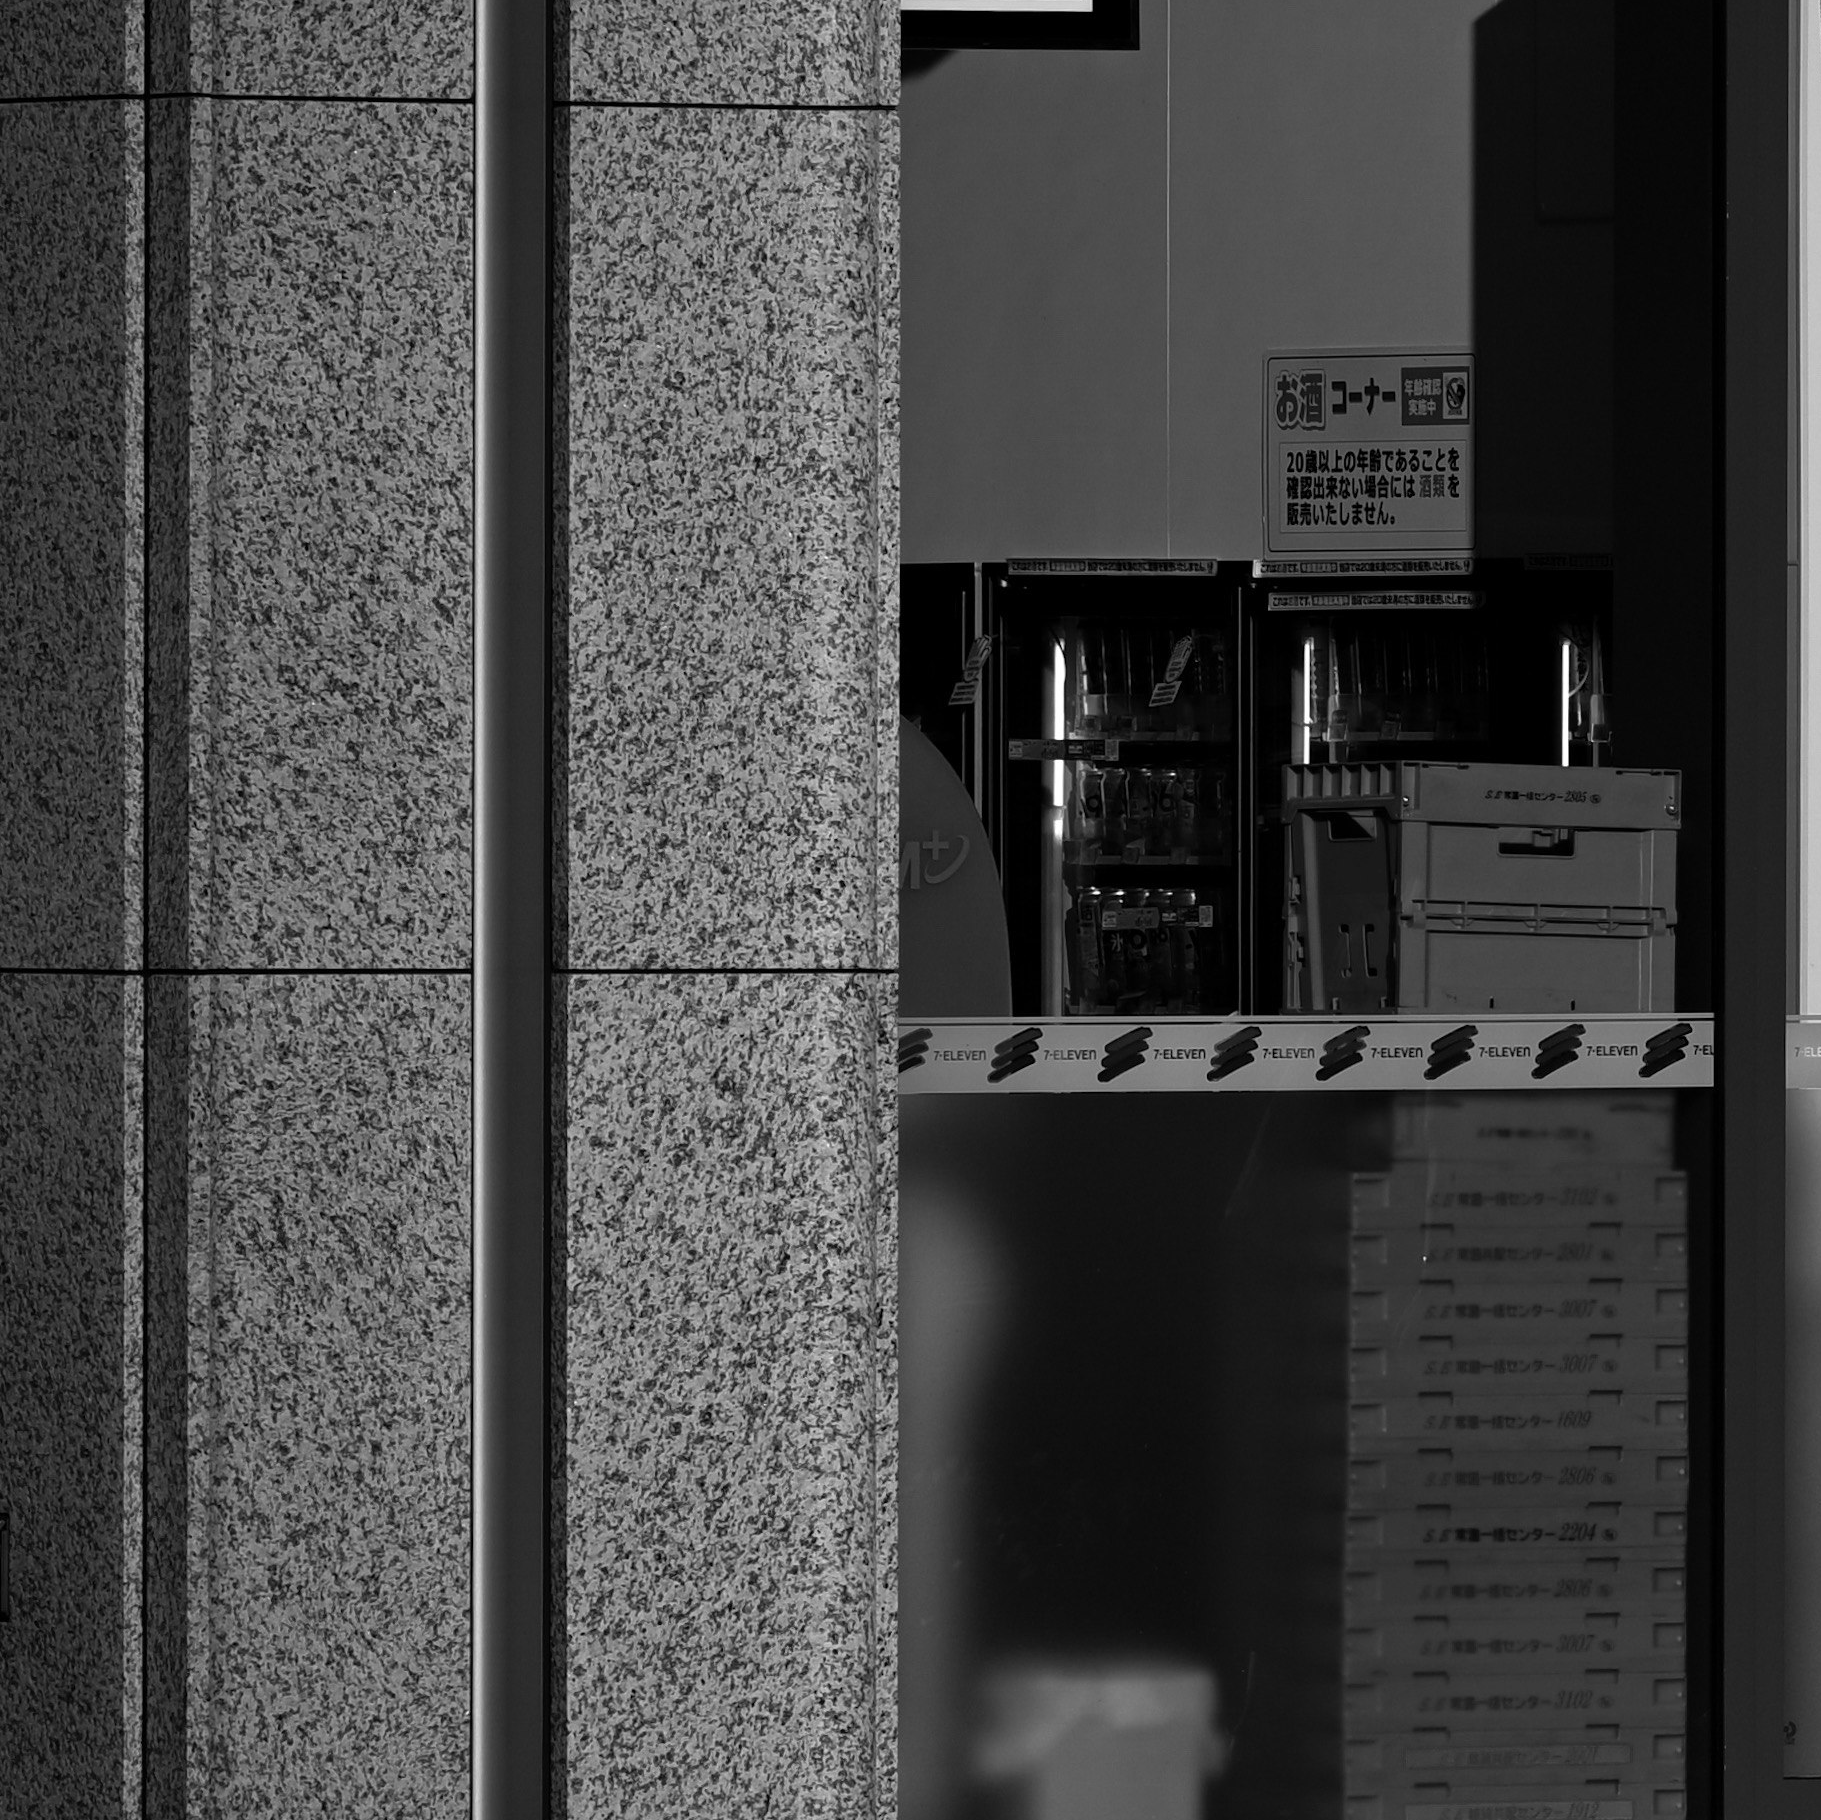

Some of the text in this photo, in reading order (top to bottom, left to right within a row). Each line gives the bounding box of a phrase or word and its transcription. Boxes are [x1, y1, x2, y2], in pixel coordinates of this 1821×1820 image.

[1287, 447, 1460, 473] 20歳以上の年齢であることを
[1287, 501, 1396, 526] 販売いたしません。
[1558, 1523, 1598, 1542] 2204
